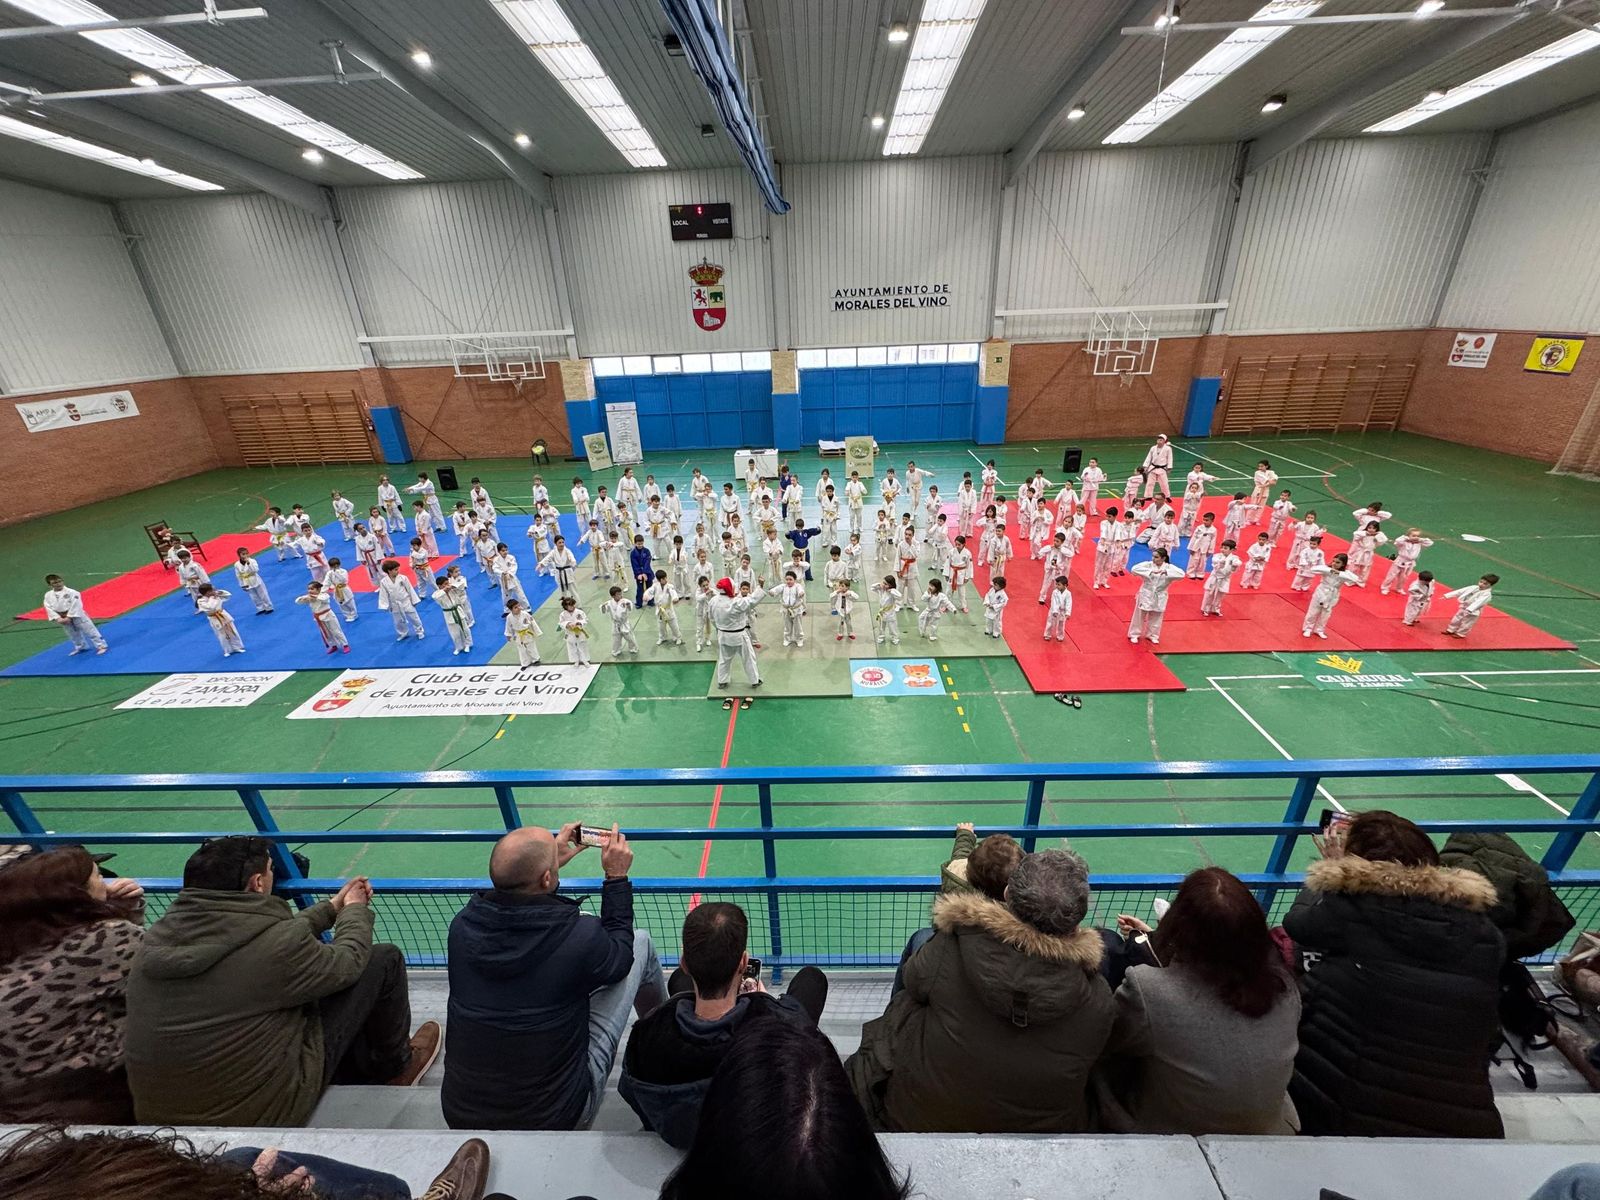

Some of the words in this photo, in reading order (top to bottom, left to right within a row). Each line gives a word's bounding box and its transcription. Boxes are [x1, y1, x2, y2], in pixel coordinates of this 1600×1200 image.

[835, 285, 928, 298] AYUNTAMIENTO
[933, 284, 948, 293] DE
[834, 299, 890, 311] MORALES
[893, 298, 915, 308] DEL
[918, 296, 947, 307] VINO
[410, 674, 463, 684] Club
[469, 672, 499, 682] de
[501, 670, 562, 682] Judo
[182, 685, 260, 694] ZAMORA
[369, 689, 396, 698] de
[400, 687, 489, 698] Morales
[493, 685, 526, 696] del
[532, 684, 580, 695] Vino
[134, 697, 246, 706] deportes
